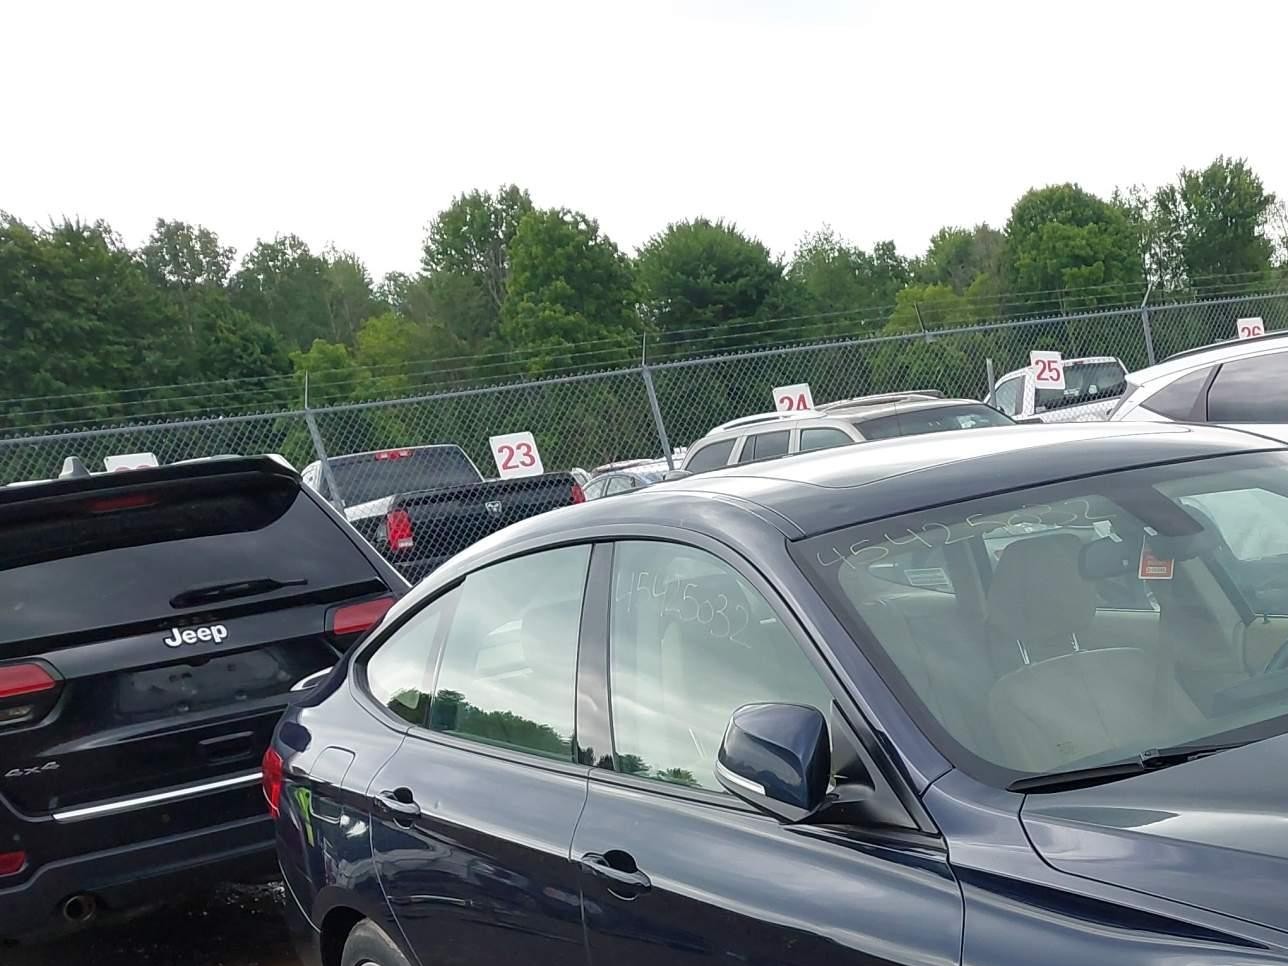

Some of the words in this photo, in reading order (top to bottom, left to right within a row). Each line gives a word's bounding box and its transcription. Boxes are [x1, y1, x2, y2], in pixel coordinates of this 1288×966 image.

[1035, 359, 1061, 382] 25
[779, 393, 812, 411] 24
[497, 442, 536, 470] 23
[163, 624, 228, 648] Jeep
[4, 761, 61, 777] 4x4
